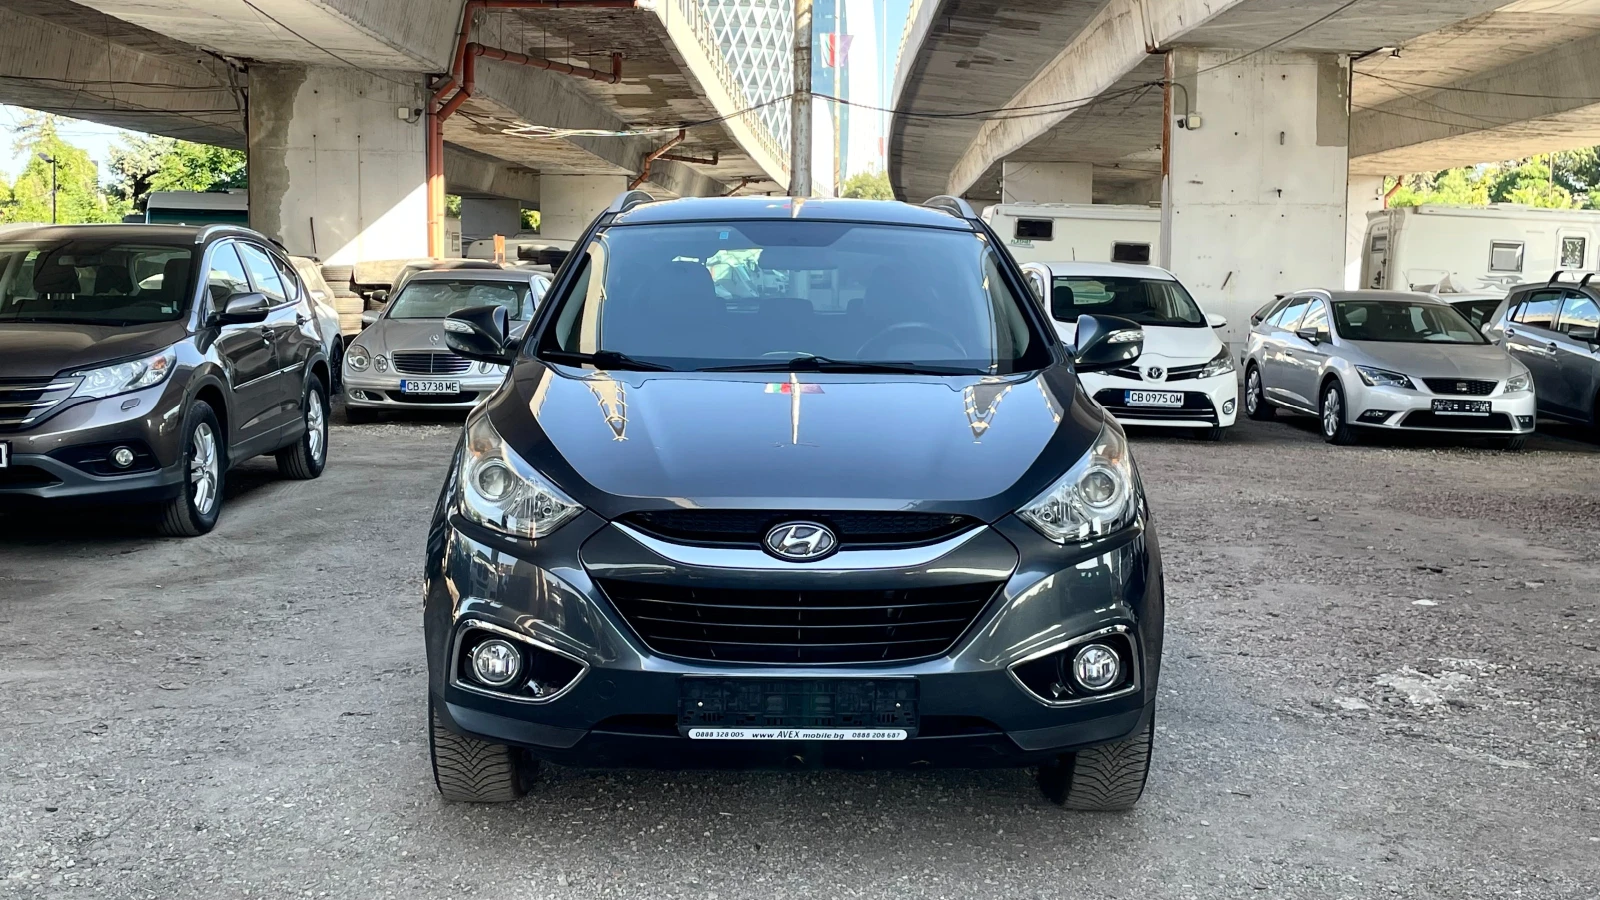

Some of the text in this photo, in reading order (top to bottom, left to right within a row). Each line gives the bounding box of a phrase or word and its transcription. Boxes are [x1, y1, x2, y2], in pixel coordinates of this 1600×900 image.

[407, 382, 458, 392] CB 3738 ME
[1132, 392, 1182, 404] CB 0975 OM
[776, 730, 800, 738] AVEX
